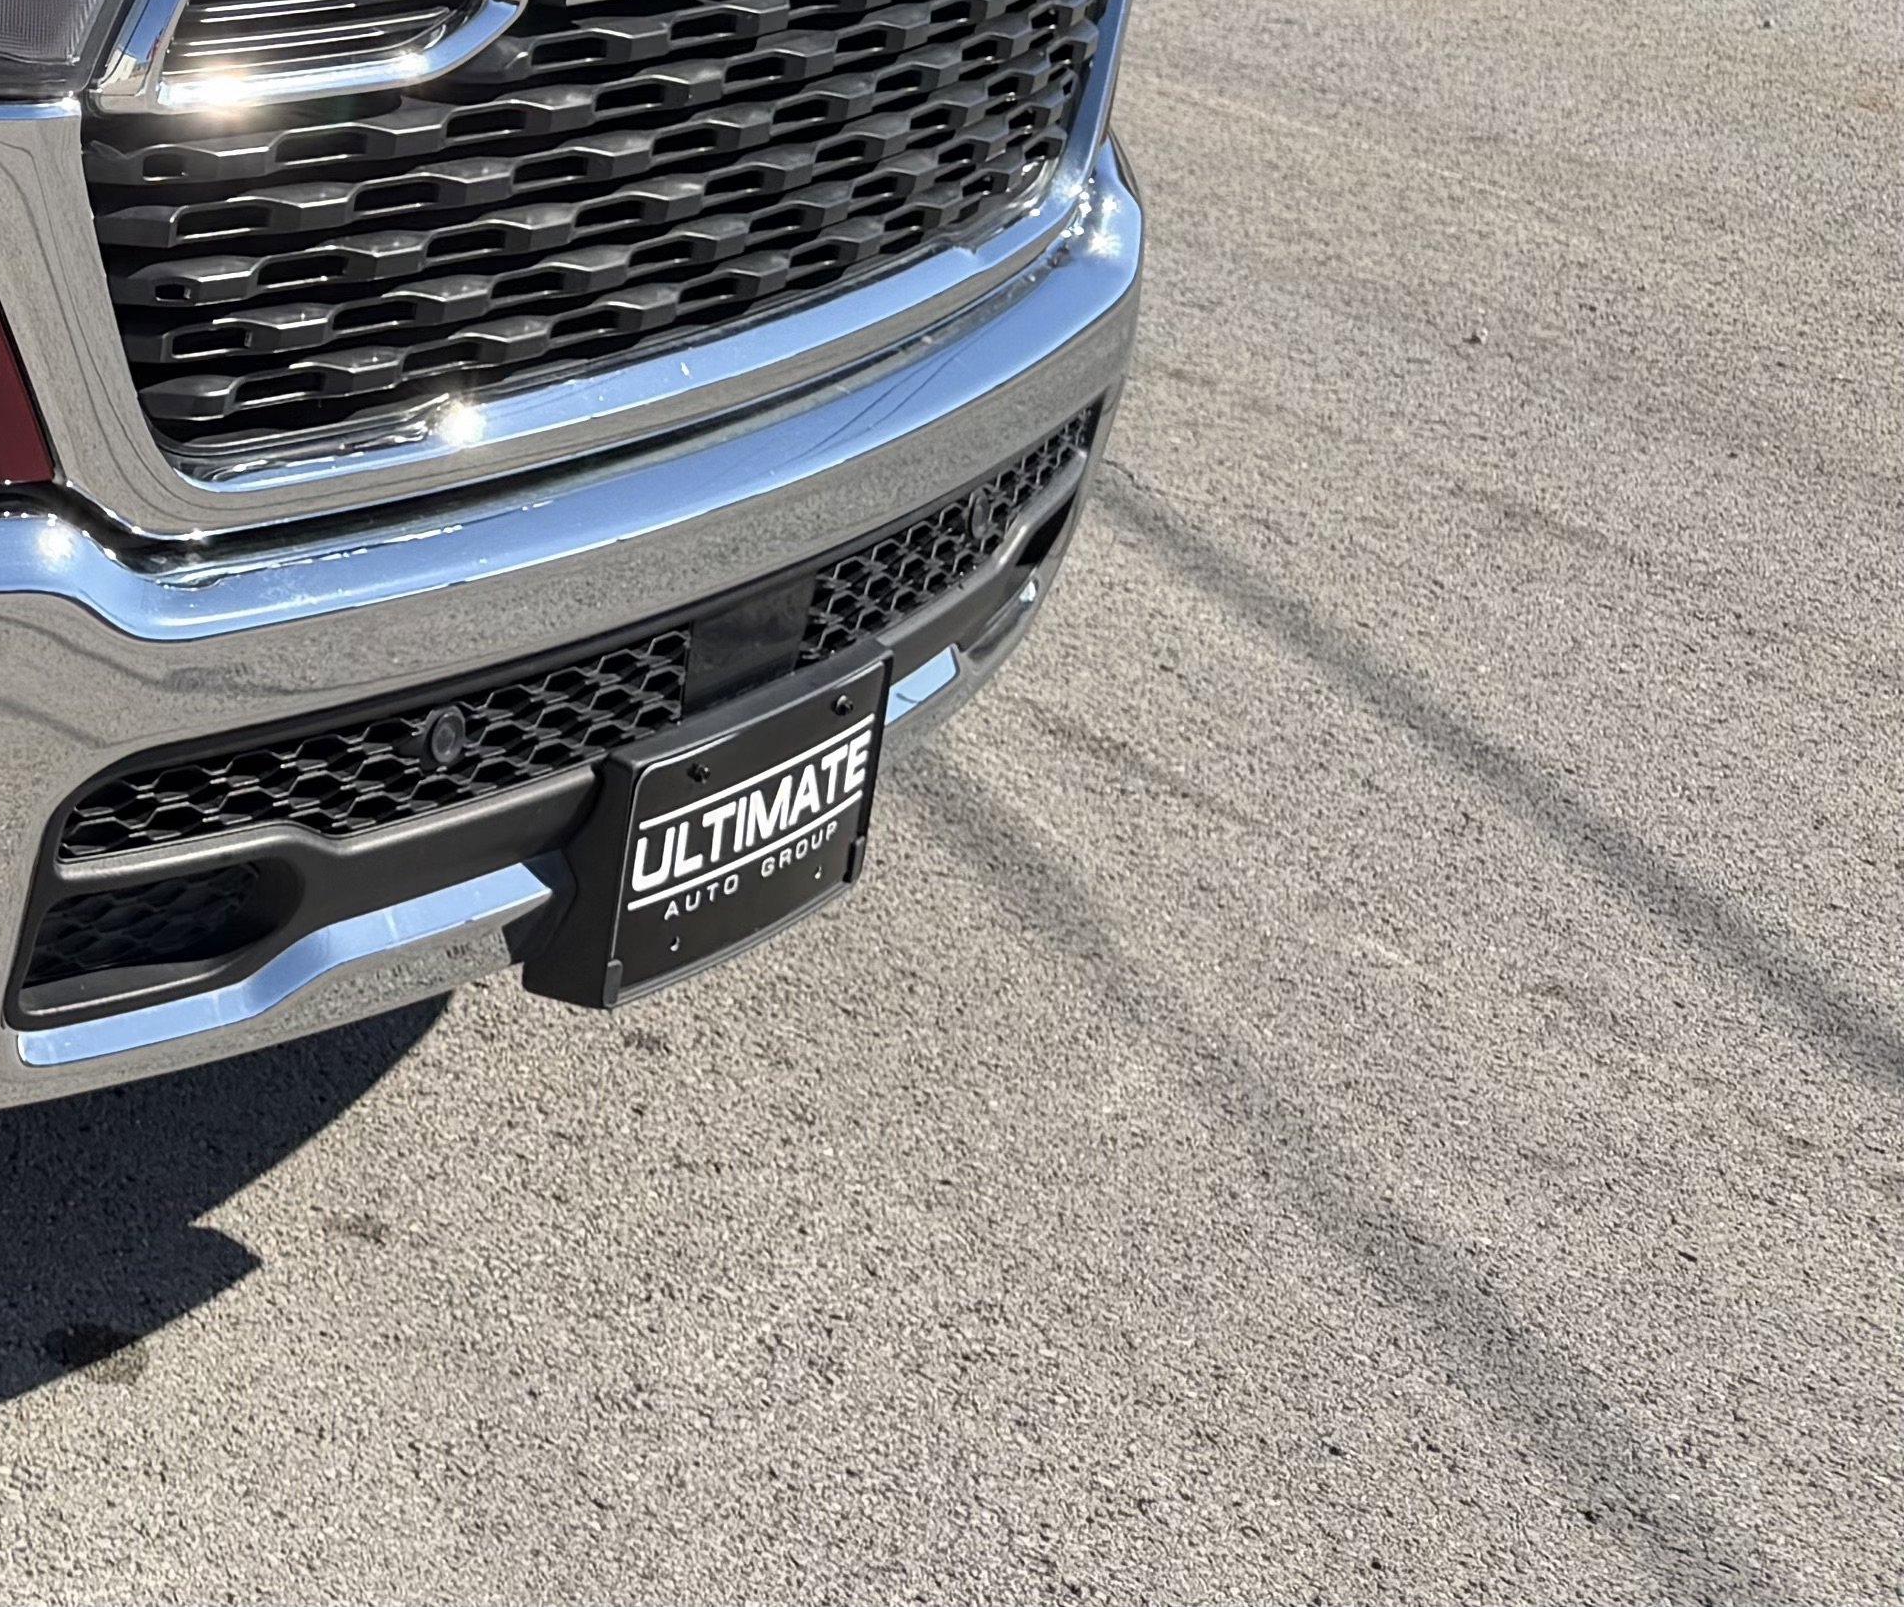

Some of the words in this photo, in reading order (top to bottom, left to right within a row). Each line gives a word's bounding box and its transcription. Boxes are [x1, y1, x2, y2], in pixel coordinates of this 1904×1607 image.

[630, 729, 873, 894] ULTIMATE
[663, 873, 740, 921] AUTO
[760, 821, 838, 879] GROUP
